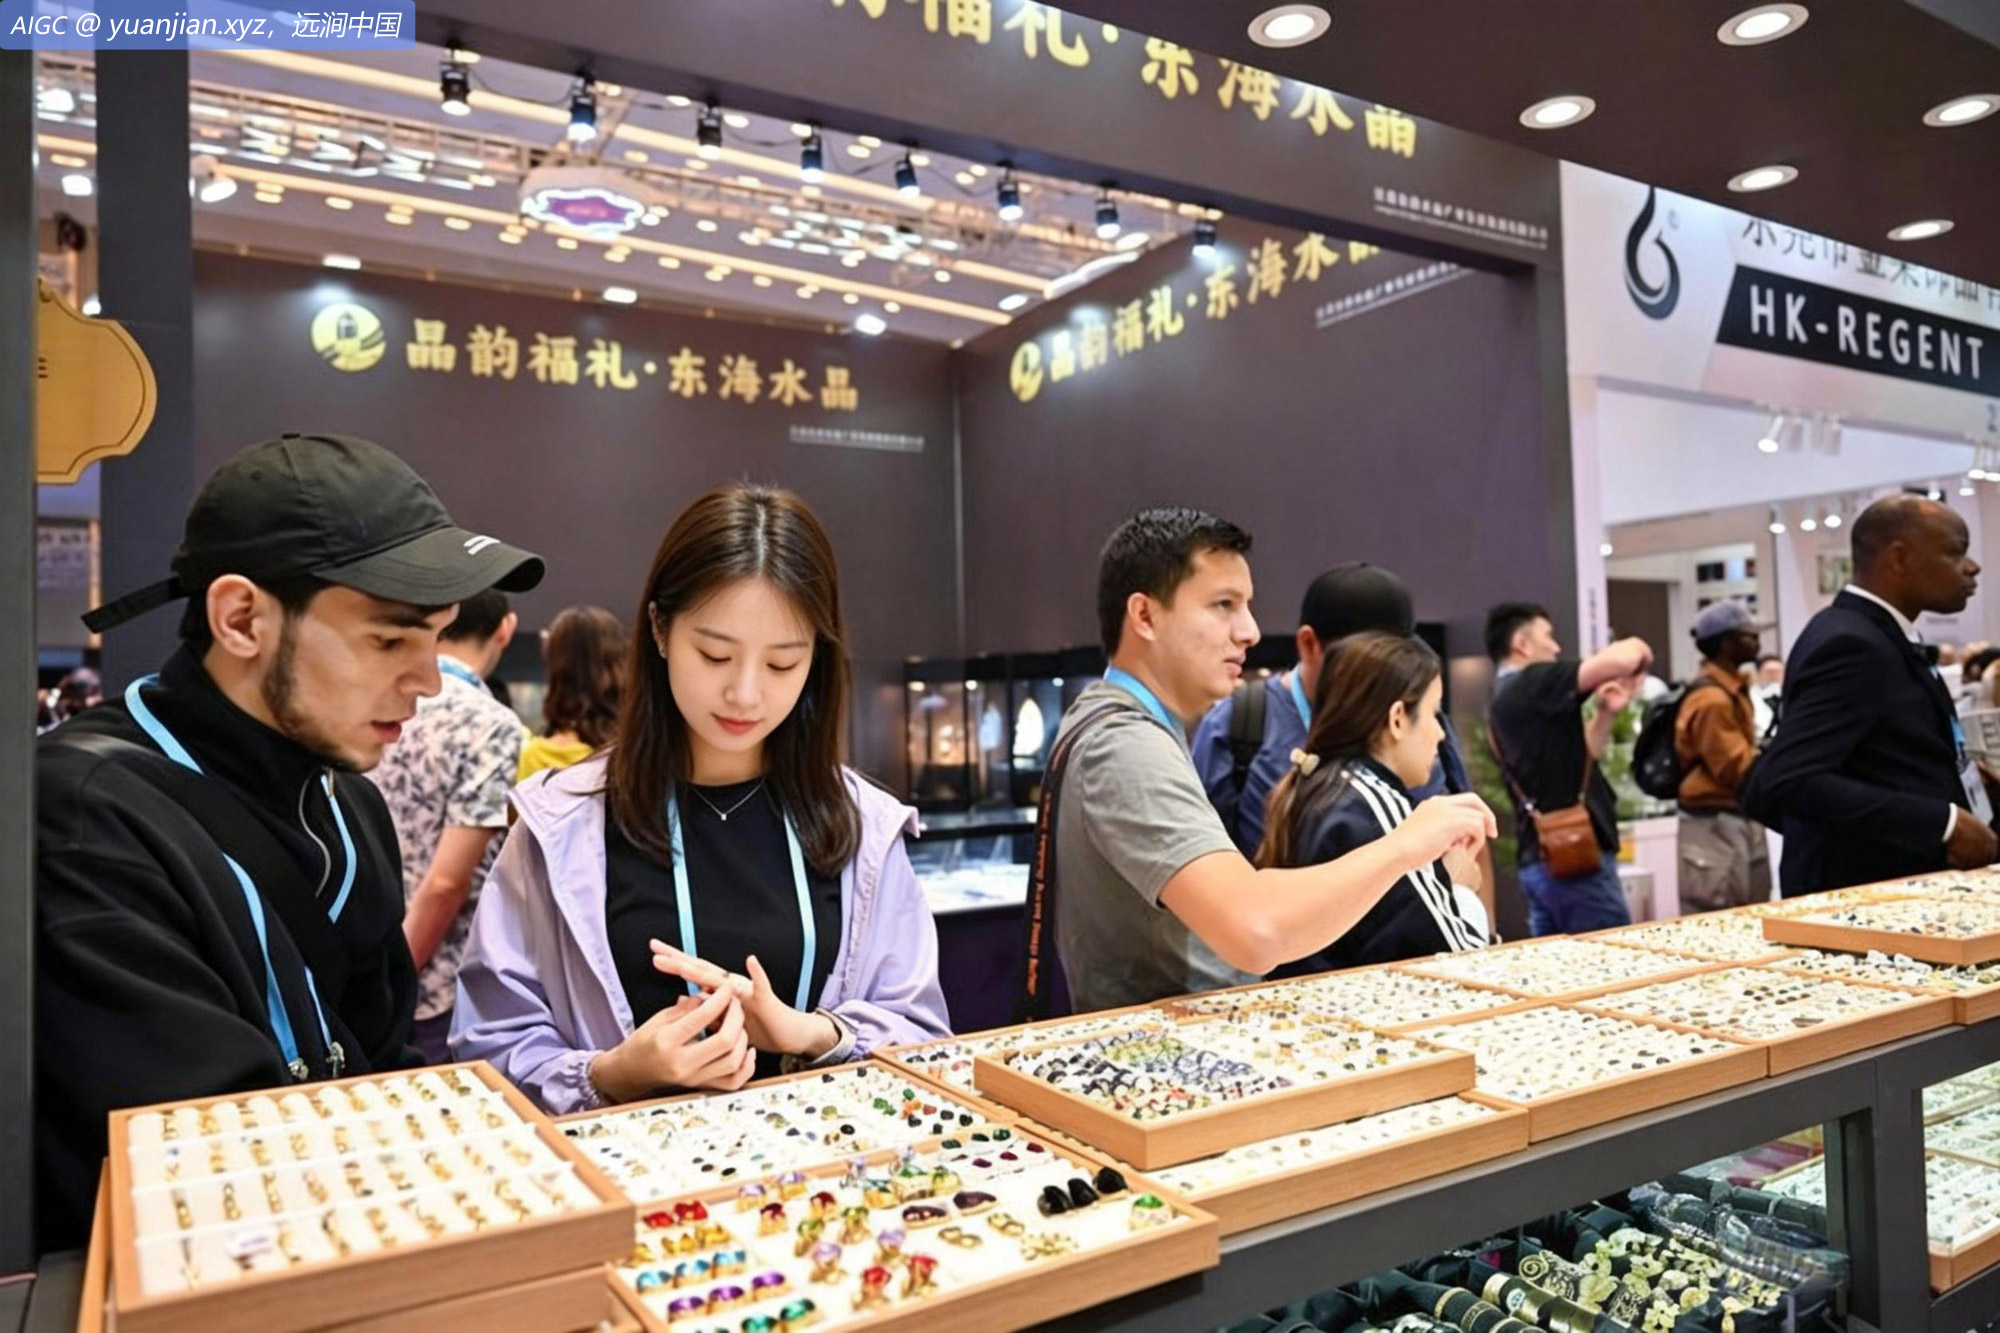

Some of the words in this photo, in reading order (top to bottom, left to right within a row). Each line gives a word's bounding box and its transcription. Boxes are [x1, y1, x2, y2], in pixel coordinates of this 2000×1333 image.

[830, 0, 1416, 158] 福礼·东海水晶
[1750, 284, 1984, 380] HK-REGENT
